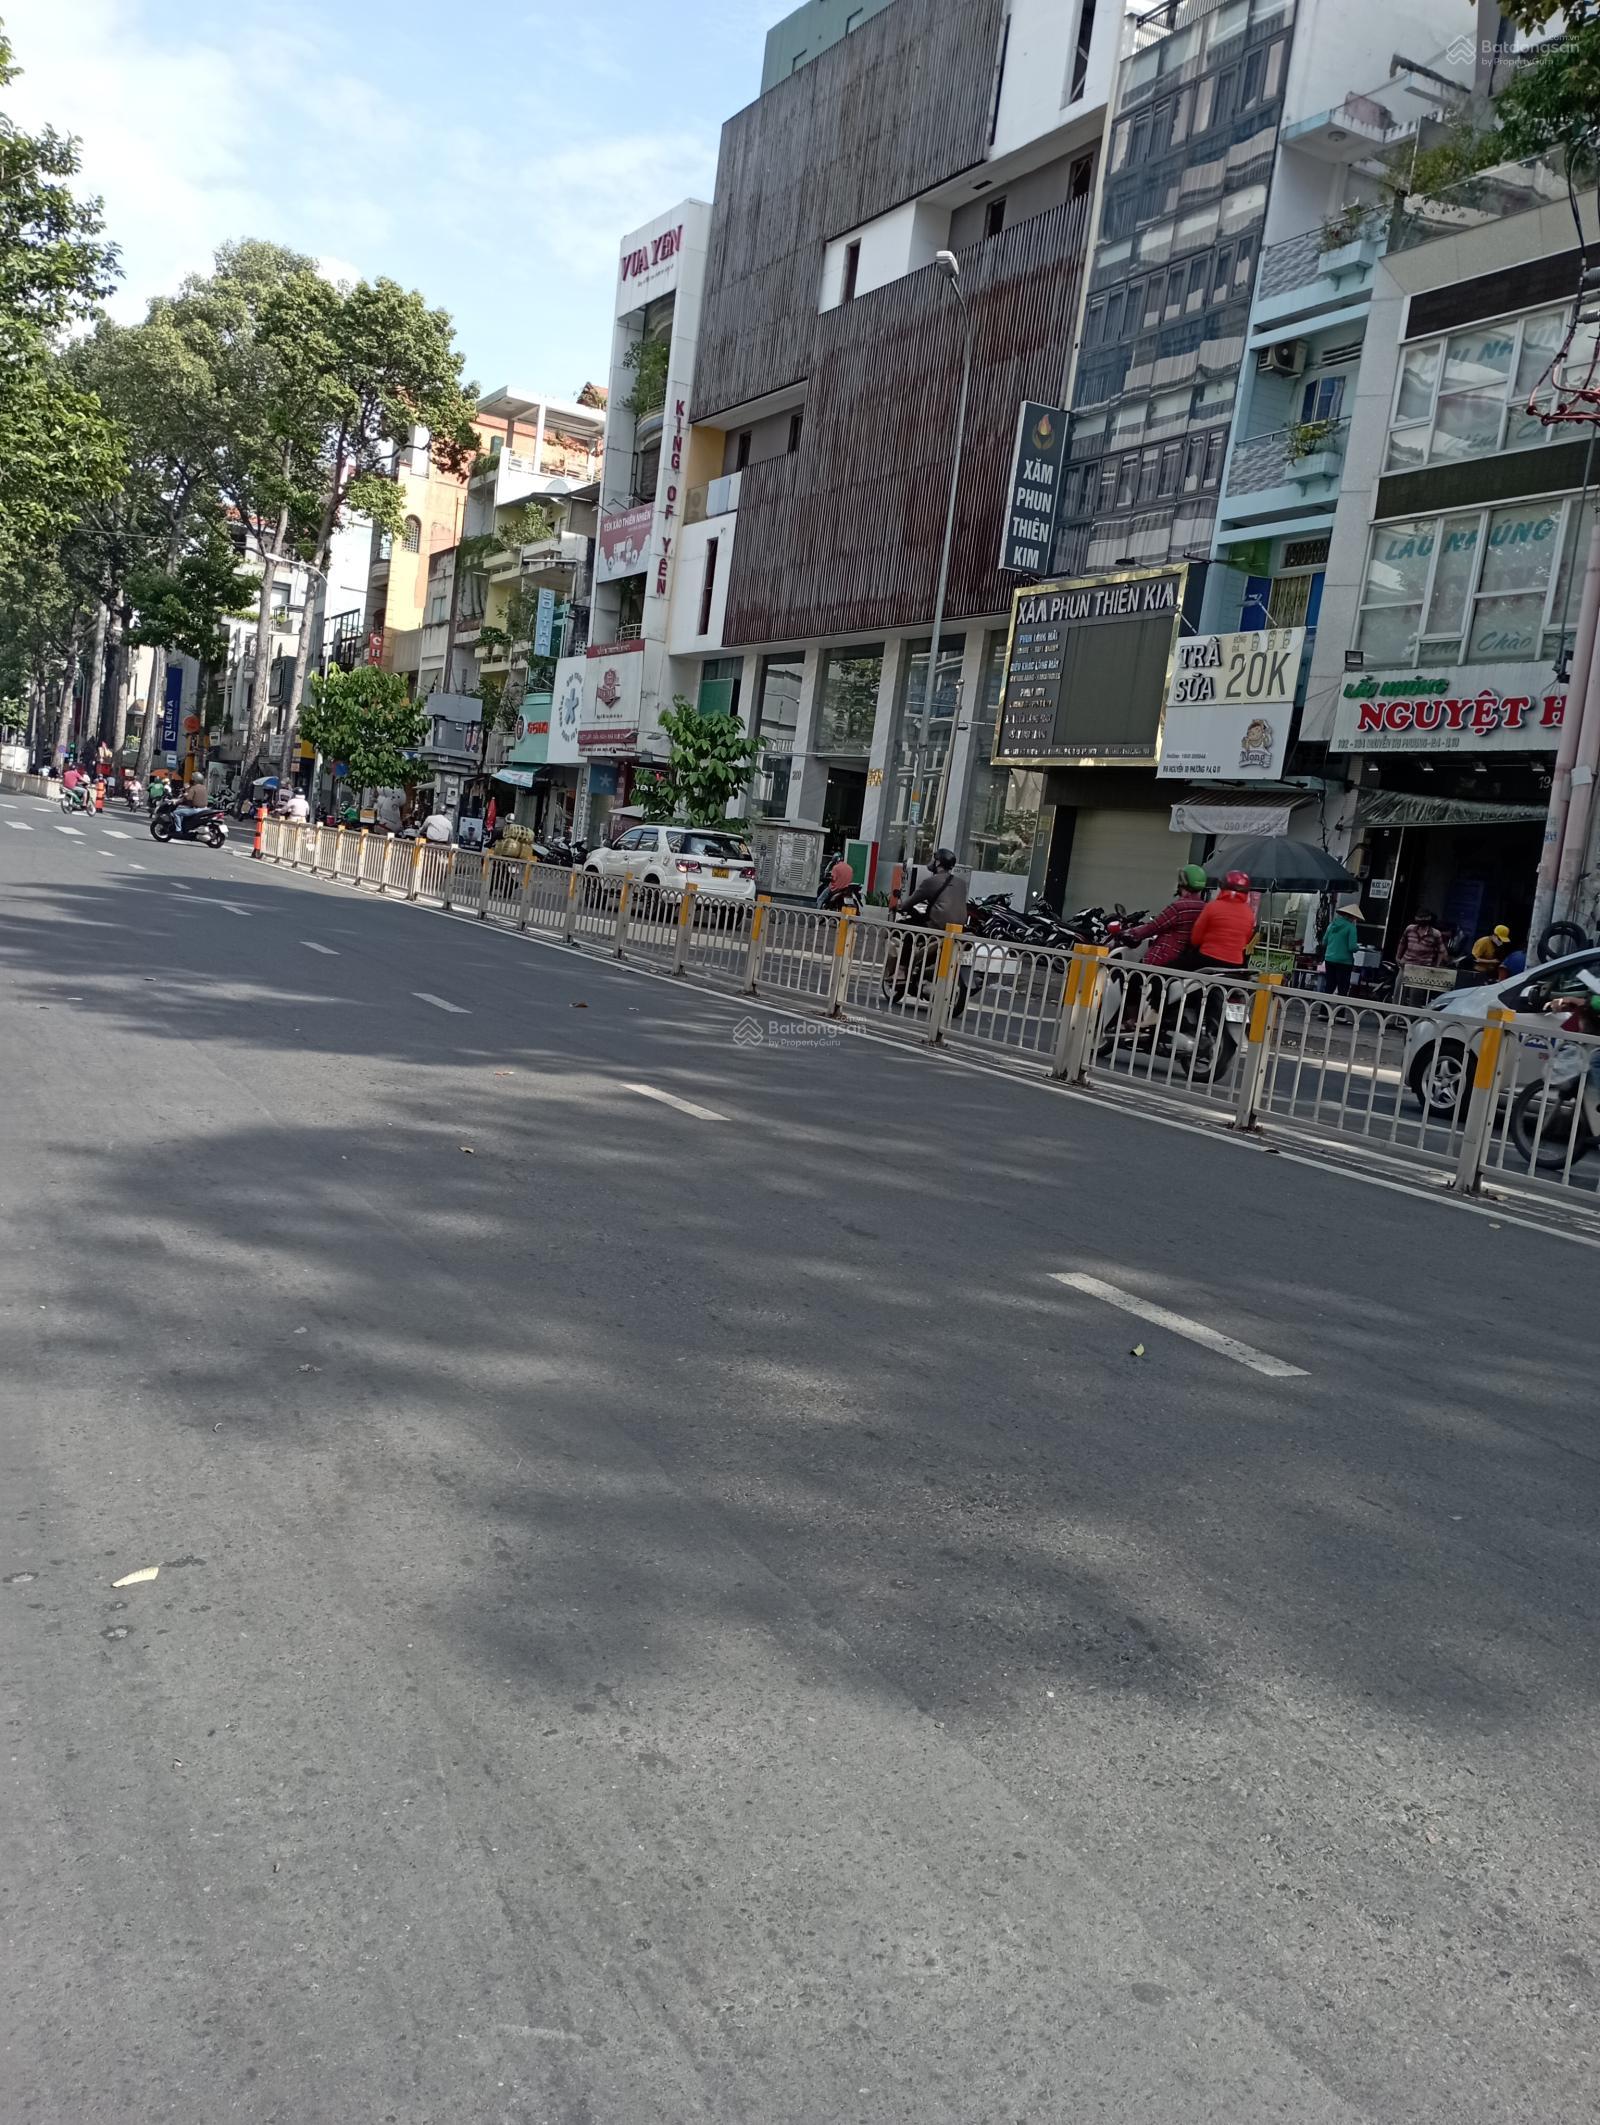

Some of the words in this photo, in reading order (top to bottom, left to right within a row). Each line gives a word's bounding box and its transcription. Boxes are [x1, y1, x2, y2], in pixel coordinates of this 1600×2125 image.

[621, 246, 649, 281] VUA
[671, 400, 685, 470] KING
[1023, 457, 1054, 485] XĂM
[665, 485, 677, 520] OF
[1016, 487, 1053, 514] PHUN
[1012, 517, 1050, 543] THIÊN
[1013, 546, 1040, 569] KIM
[1016, 596, 1047, 625] XĂM
[1050, 592, 1091, 622] PHUN
[1094, 584, 1139, 616] THIÊN
[1143, 582, 1174, 611] KIM
[1180, 636, 1222, 669] TRÀ
[1226, 651, 1291, 698] 20K
[1357, 688, 1532, 736] NGUYỆT
